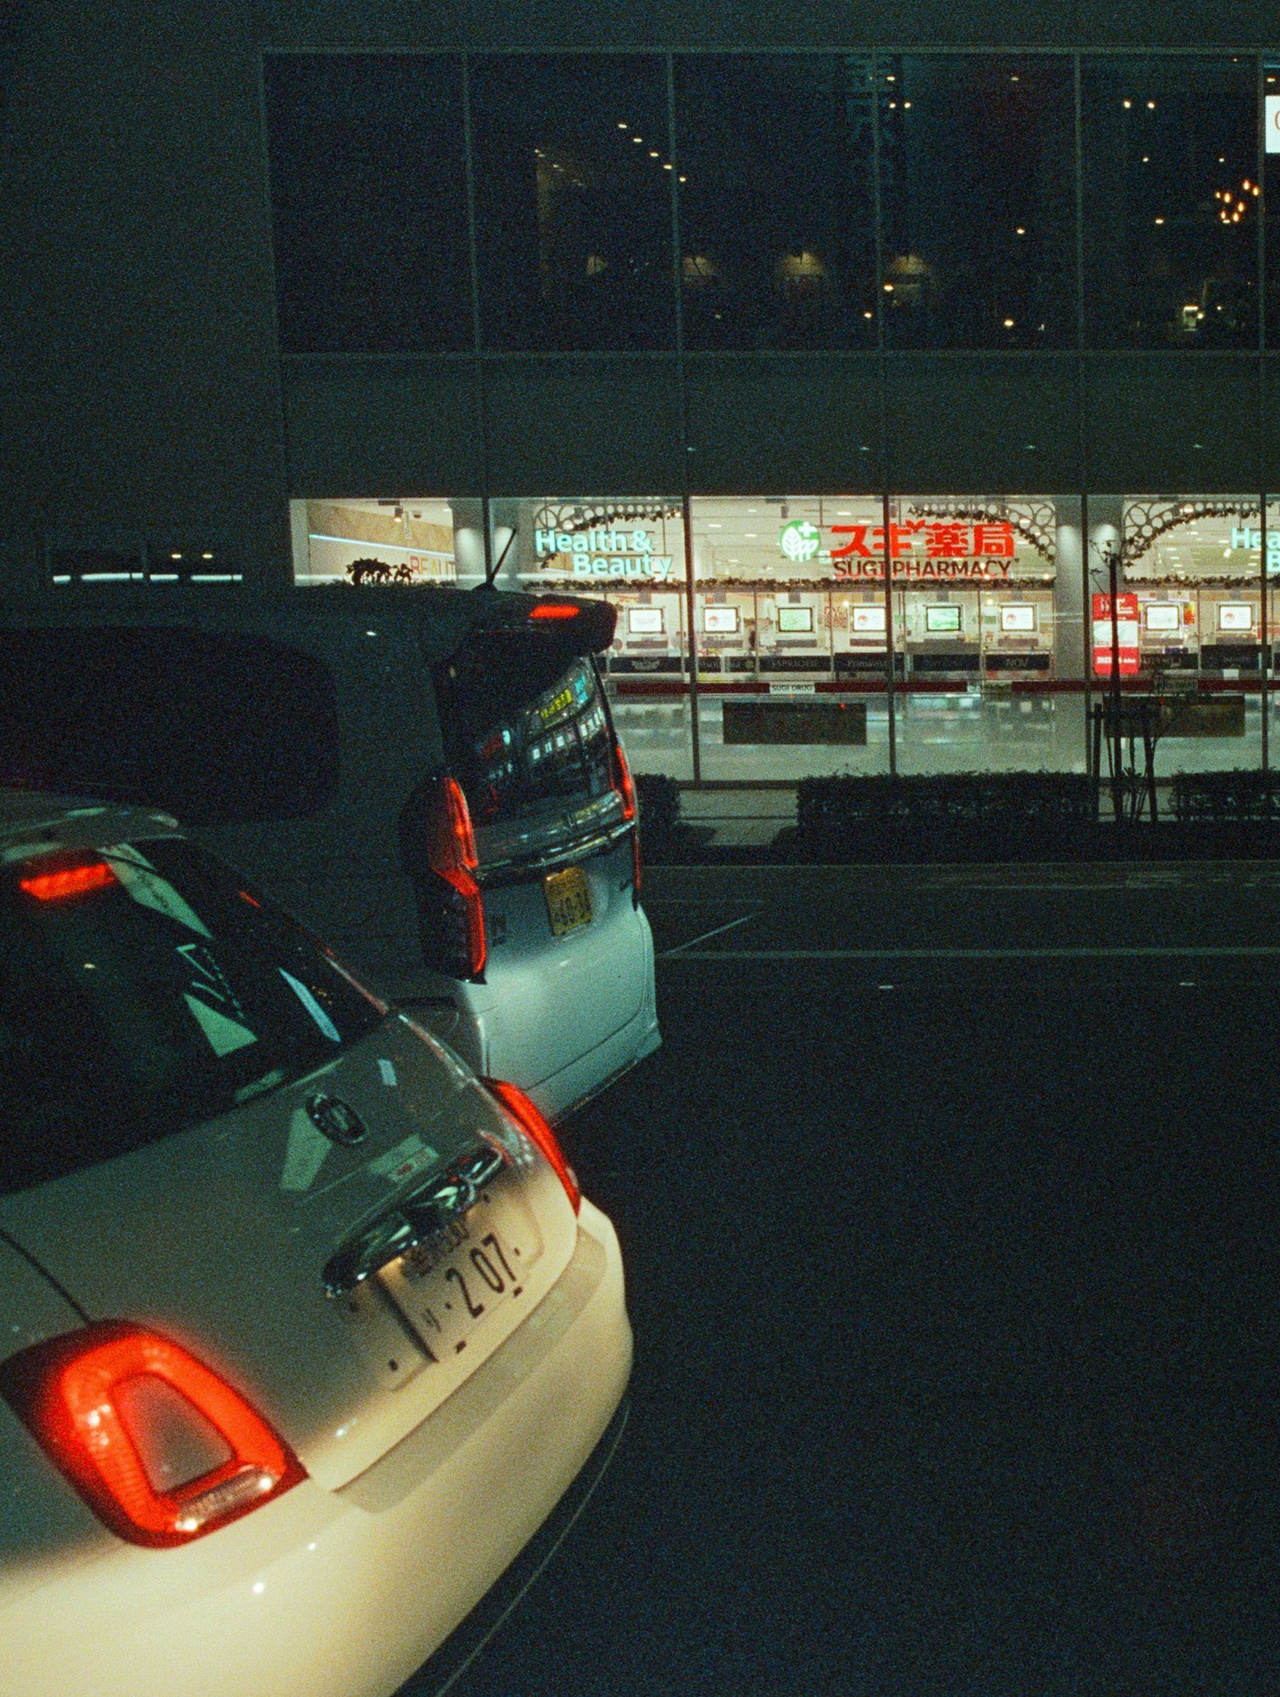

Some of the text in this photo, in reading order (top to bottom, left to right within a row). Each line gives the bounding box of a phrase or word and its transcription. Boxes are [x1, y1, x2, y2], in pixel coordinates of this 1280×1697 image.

[535, 529, 627, 553] Health
[829, 519, 1015, 558] スギ薬局
[572, 553, 673, 579] Beauty
[833, 560, 1012, 578] SUGI PHARMACY
